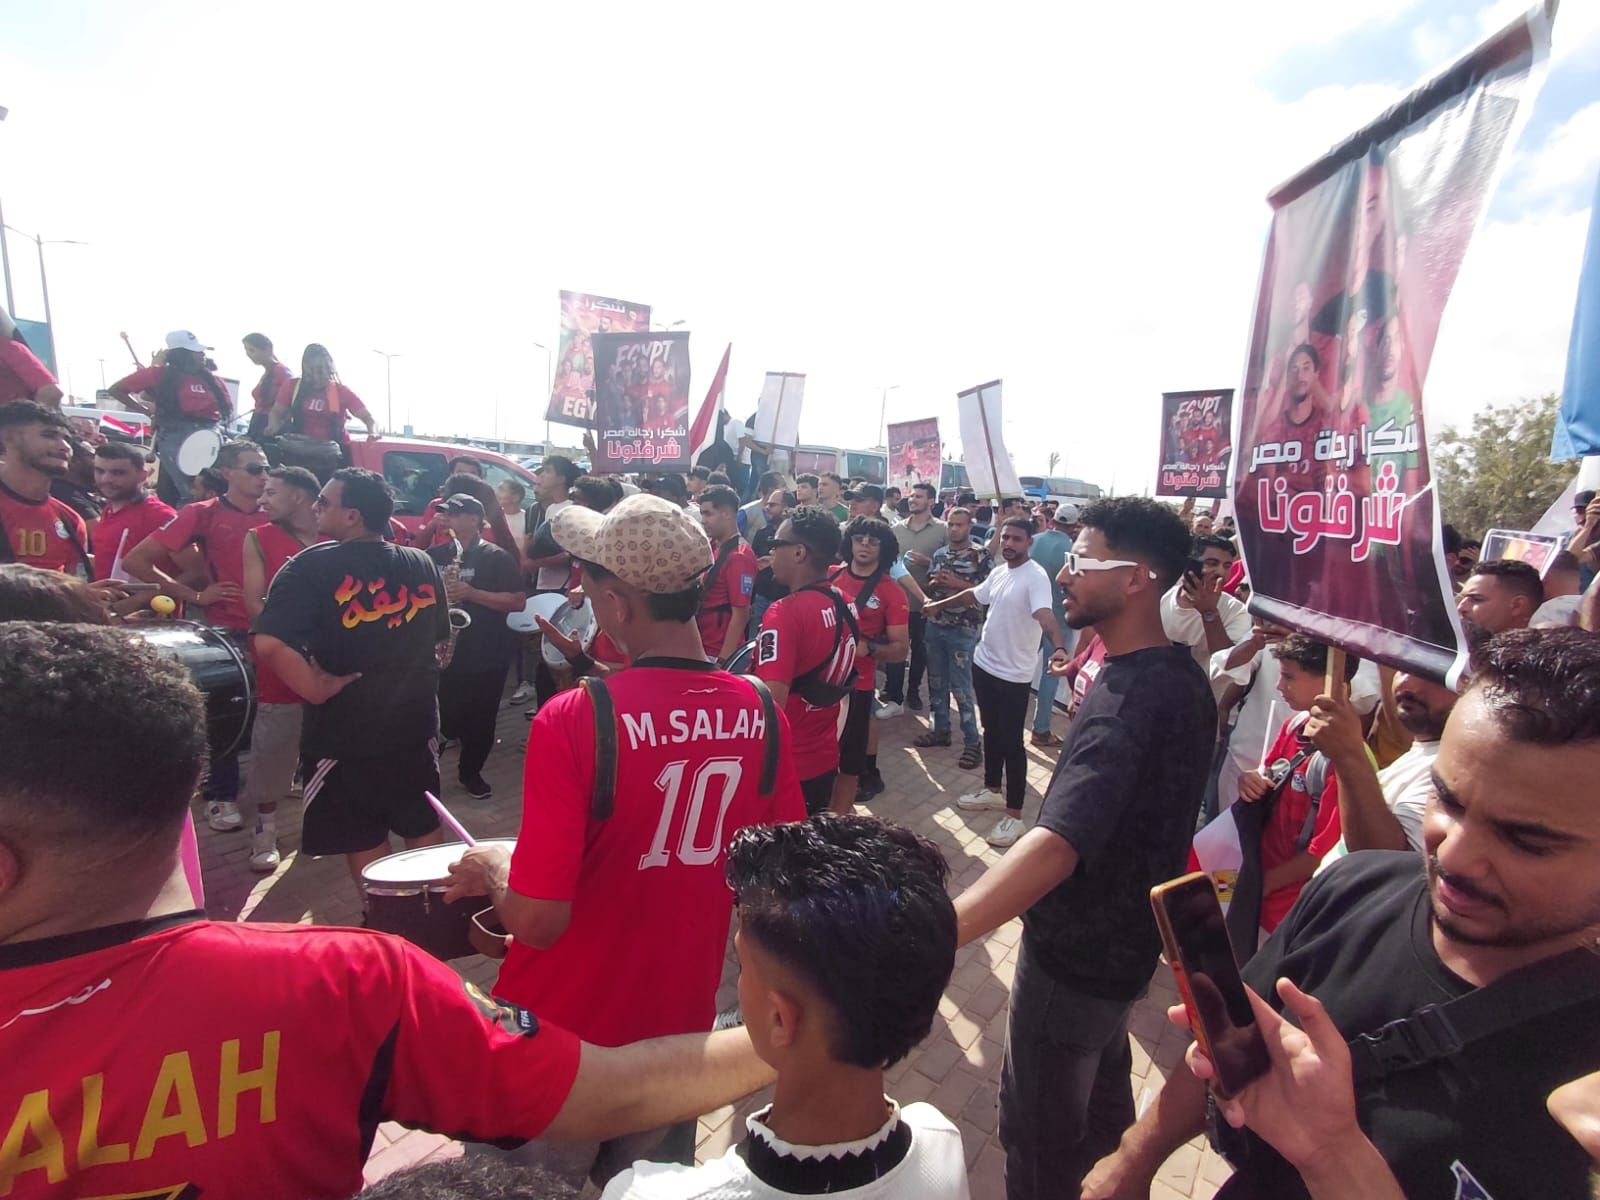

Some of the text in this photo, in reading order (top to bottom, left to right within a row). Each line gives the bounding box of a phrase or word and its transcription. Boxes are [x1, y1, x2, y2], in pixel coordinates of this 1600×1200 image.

[616, 340, 674, 370] EGYPT
[1177, 396, 1222, 418] EGYPT
[603, 429, 625, 439] مصر
[657, 424, 686, 439] شكرا
[607, 437, 681, 464] شرفتونا
[1249, 440, 1302, 473] مصر
[1203, 462, 1226, 472] شكرا
[1258, 461, 1406, 562] شرفتونا
[16, 528, 47, 557] 10
[621, 708, 766, 750] M.SALAH
[638, 756, 743, 870] 10
